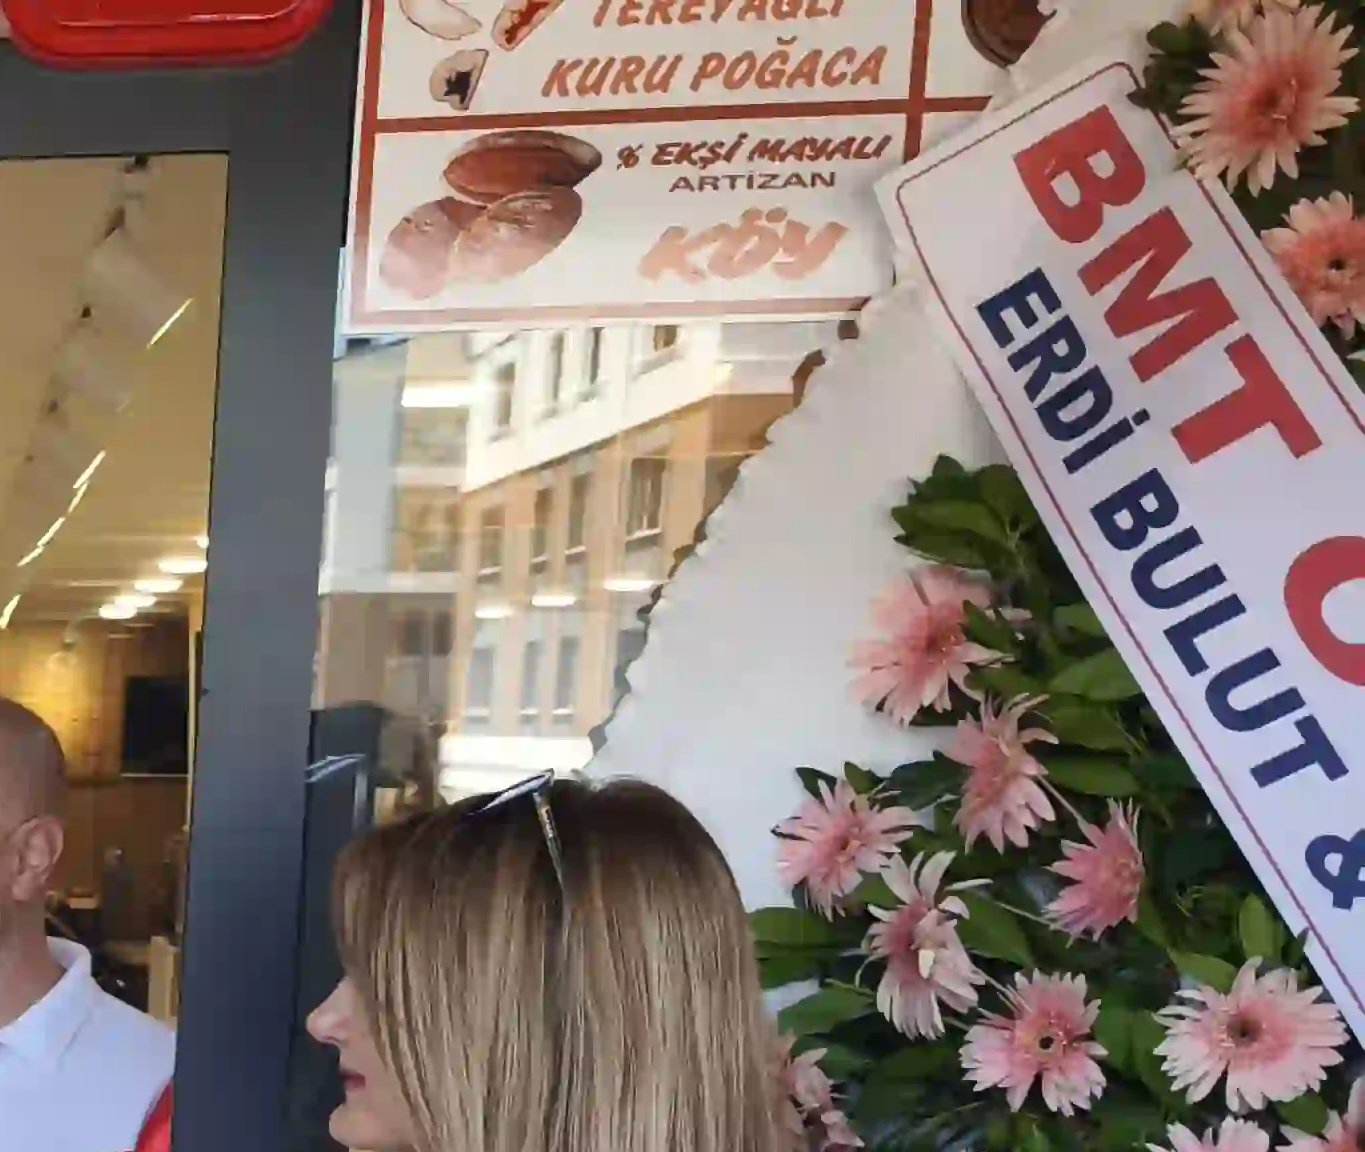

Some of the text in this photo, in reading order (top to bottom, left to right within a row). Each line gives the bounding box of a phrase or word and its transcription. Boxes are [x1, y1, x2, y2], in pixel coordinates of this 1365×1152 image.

[541, 35, 889, 98] KURU POĞACA
[650, 132, 748, 170] EKŞİ
[747, 134, 893, 164] MAYALI
[668, 170, 837, 193] ARTİZAN
[1013, 104, 1323, 465] BMT
[975, 267, 1151, 475] ERDİ
[1089, 467, 1350, 789] BULUT
